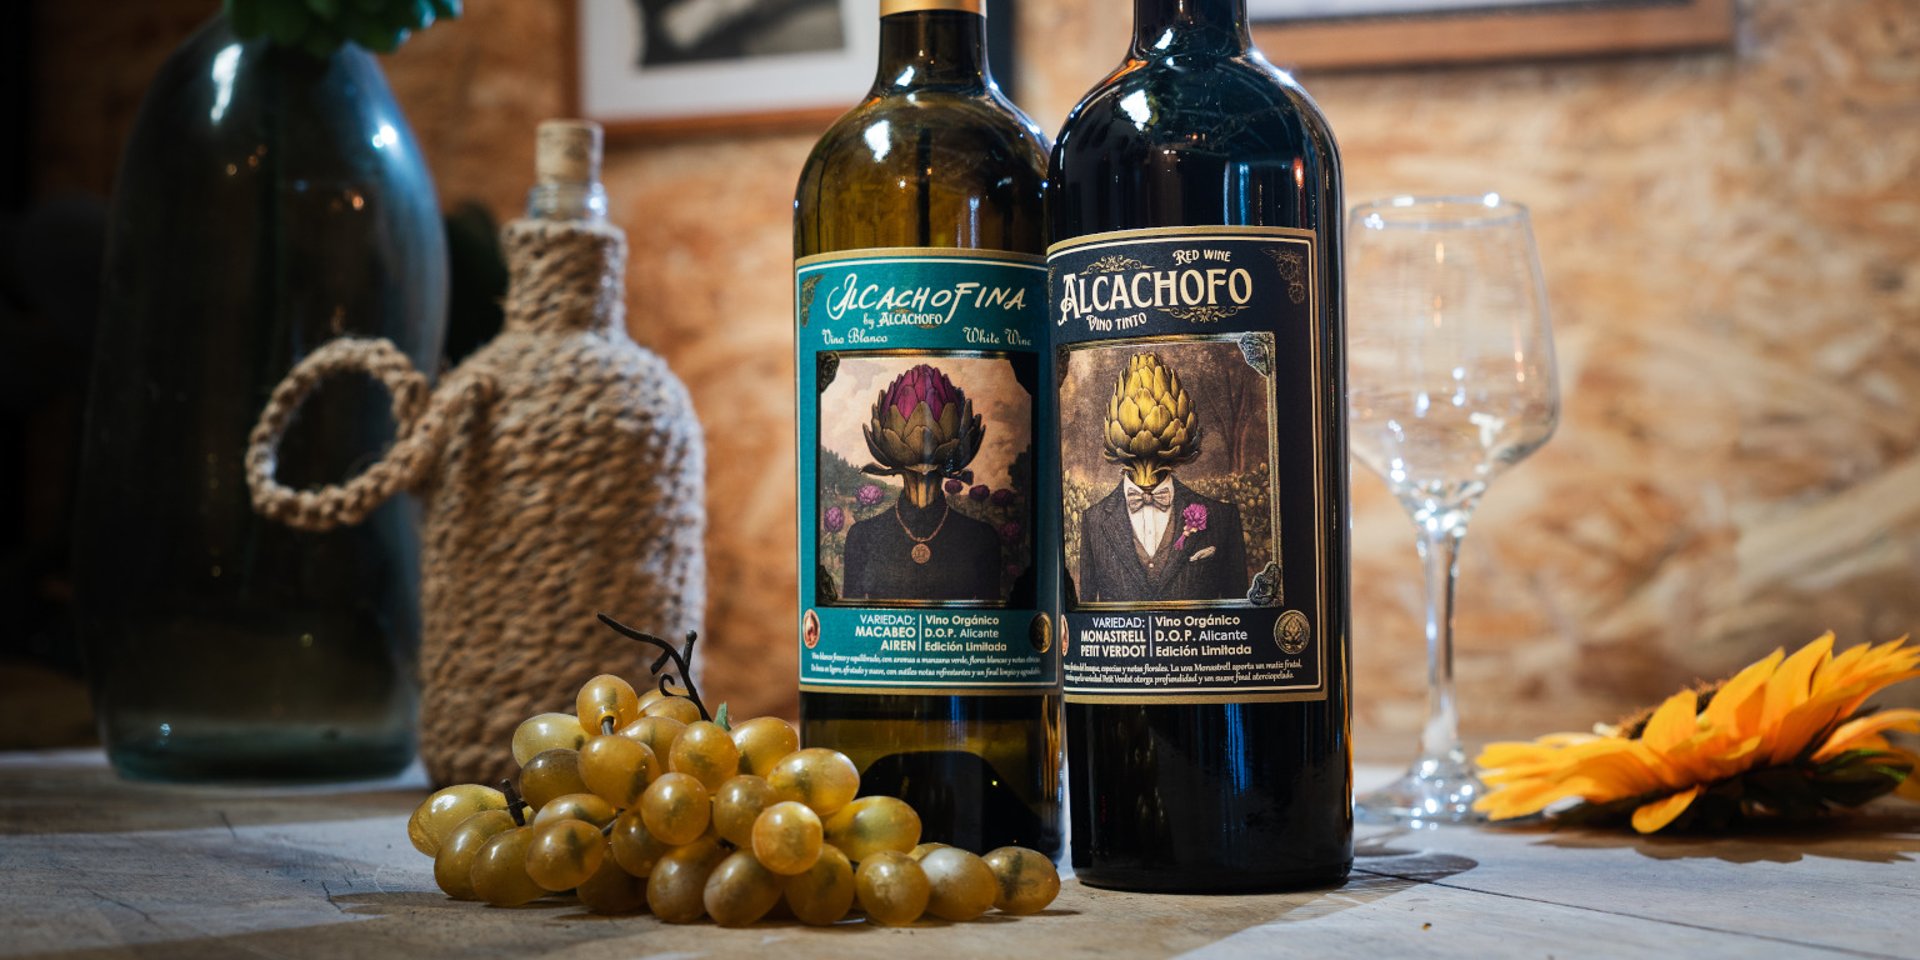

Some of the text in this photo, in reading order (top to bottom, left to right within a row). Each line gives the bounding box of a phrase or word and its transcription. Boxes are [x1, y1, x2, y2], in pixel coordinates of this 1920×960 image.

[1172, 249, 1232, 265] RED WINE
[1057, 268, 1253, 327] ALCACHOFO
[863, 312, 943, 329] by ALCACHOFO
[1086, 312, 1147, 332] VINO TINTO
[822, 328, 888, 345] Vino Blanco
[963, 326, 1032, 346] White Wine
[859, 614, 916, 625] VARIEDAD:
[925, 614, 999, 627] Vino Orgánico
[1092, 617, 1145, 628] VARIEDAD:
[1155, 613, 1240, 628] Vino Orgánico
[855, 626, 916, 638] MACABEO
[925, 628, 999, 638] D.O.P. Alicante
[1081, 630, 1146, 642] MONASTRELL
[1155, 629, 1248, 642] D.O.P. Alicante
[880, 640, 916, 651] AIREN
[925, 641, 1007, 652] Edición Limitada
[1081, 645, 1146, 657] PETIT VERDOT
[1155, 644, 1252, 656] Edición Limitada
[1170, 663, 1179, 672] La
